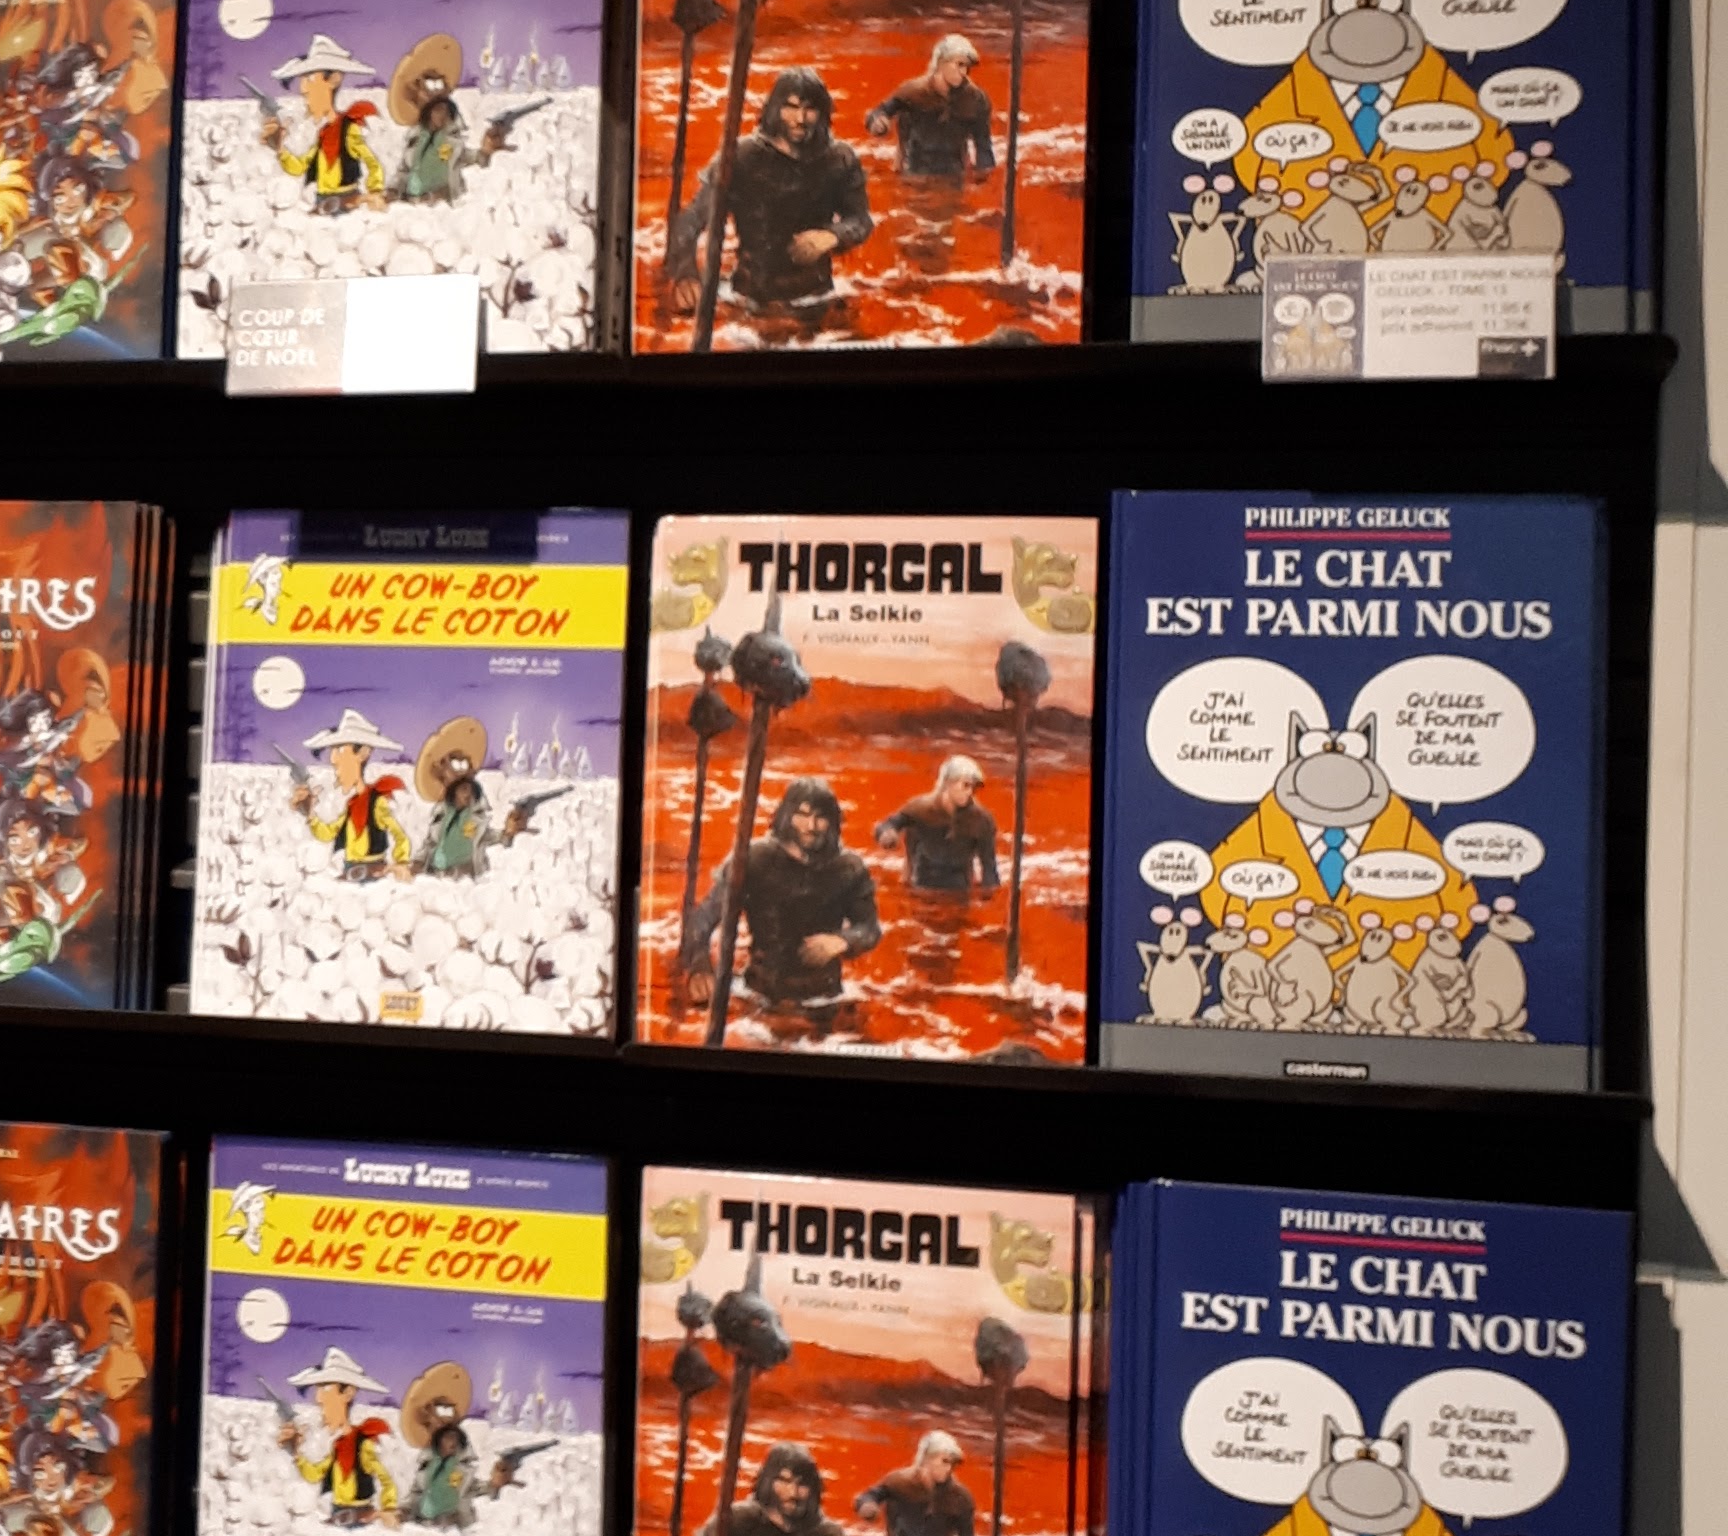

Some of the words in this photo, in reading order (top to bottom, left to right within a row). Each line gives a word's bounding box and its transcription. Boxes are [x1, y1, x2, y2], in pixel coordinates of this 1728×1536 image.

[239, 308, 295, 326] COUP
[300, 308, 325, 325] DE
[235, 350, 258, 366] DE
[1245, 507, 1353, 528] PHILIPPE
[1357, 508, 1451, 528] GELUCK
[363, 526, 431, 550] LUCKY
[740, 542, 1002, 594] THORGAL
[1245, 550, 1302, 588] LE
[1315, 550, 1452, 588] CHAT
[330, 572, 376, 599] UN
[382, 572, 539, 601] COW-BOY
[291, 605, 384, 634] DANS
[393, 607, 438, 634] LE
[443, 609, 570, 636] COTON
[812, 604, 838, 622] La
[849, 604, 922, 623] Selkie
[1145, 598, 1232, 635] EST
[1245, 598, 1399, 637] PARMI
[1415, 601, 1553, 639] NOUS
[1204, 693, 1244, 709] J'AI
[1407, 693, 1485, 708] QU'ELLES
[1190, 712, 1255, 725] COMME
[1396, 712, 1418, 727] SE
[1423, 713, 1502, 728] FOUTENT
[1210, 728, 1231, 742] LE
[1414, 731, 1438, 745] DE
[1444, 732, 1475, 745] MA
[1177, 746, 1273, 762] SENTIMENT
[1408, 749, 1481, 766] GUEULE
[1286, 1062, 1367, 1078] casterman
[343, 1157, 412, 1186] LUCKY
[414, 1162, 470, 1190] LUKE
[311, 1206, 358, 1233] UN
[364, 1210, 521, 1246] COW-BOY
[720, 1200, 980, 1268] THORGAL
[1280, 1208, 1388, 1235] PHILIPPE
[1391, 1216, 1486, 1242] GELUCK
[273, 1237, 367, 1271] DANS
[375, 1246, 421, 1274] LE
[425, 1250, 552, 1284] COTON
[791, 1268, 821, 1287] La
[829, 1269, 902, 1292] Selkie
[1279, 1251, 1339, 1289] LE
[1350, 1255, 1486, 1302] CHAT
[1181, 1291, 1269, 1334] EST
[1280, 1299, 1435, 1347] PARMI
[1448, 1314, 1587, 1360] NOUS
